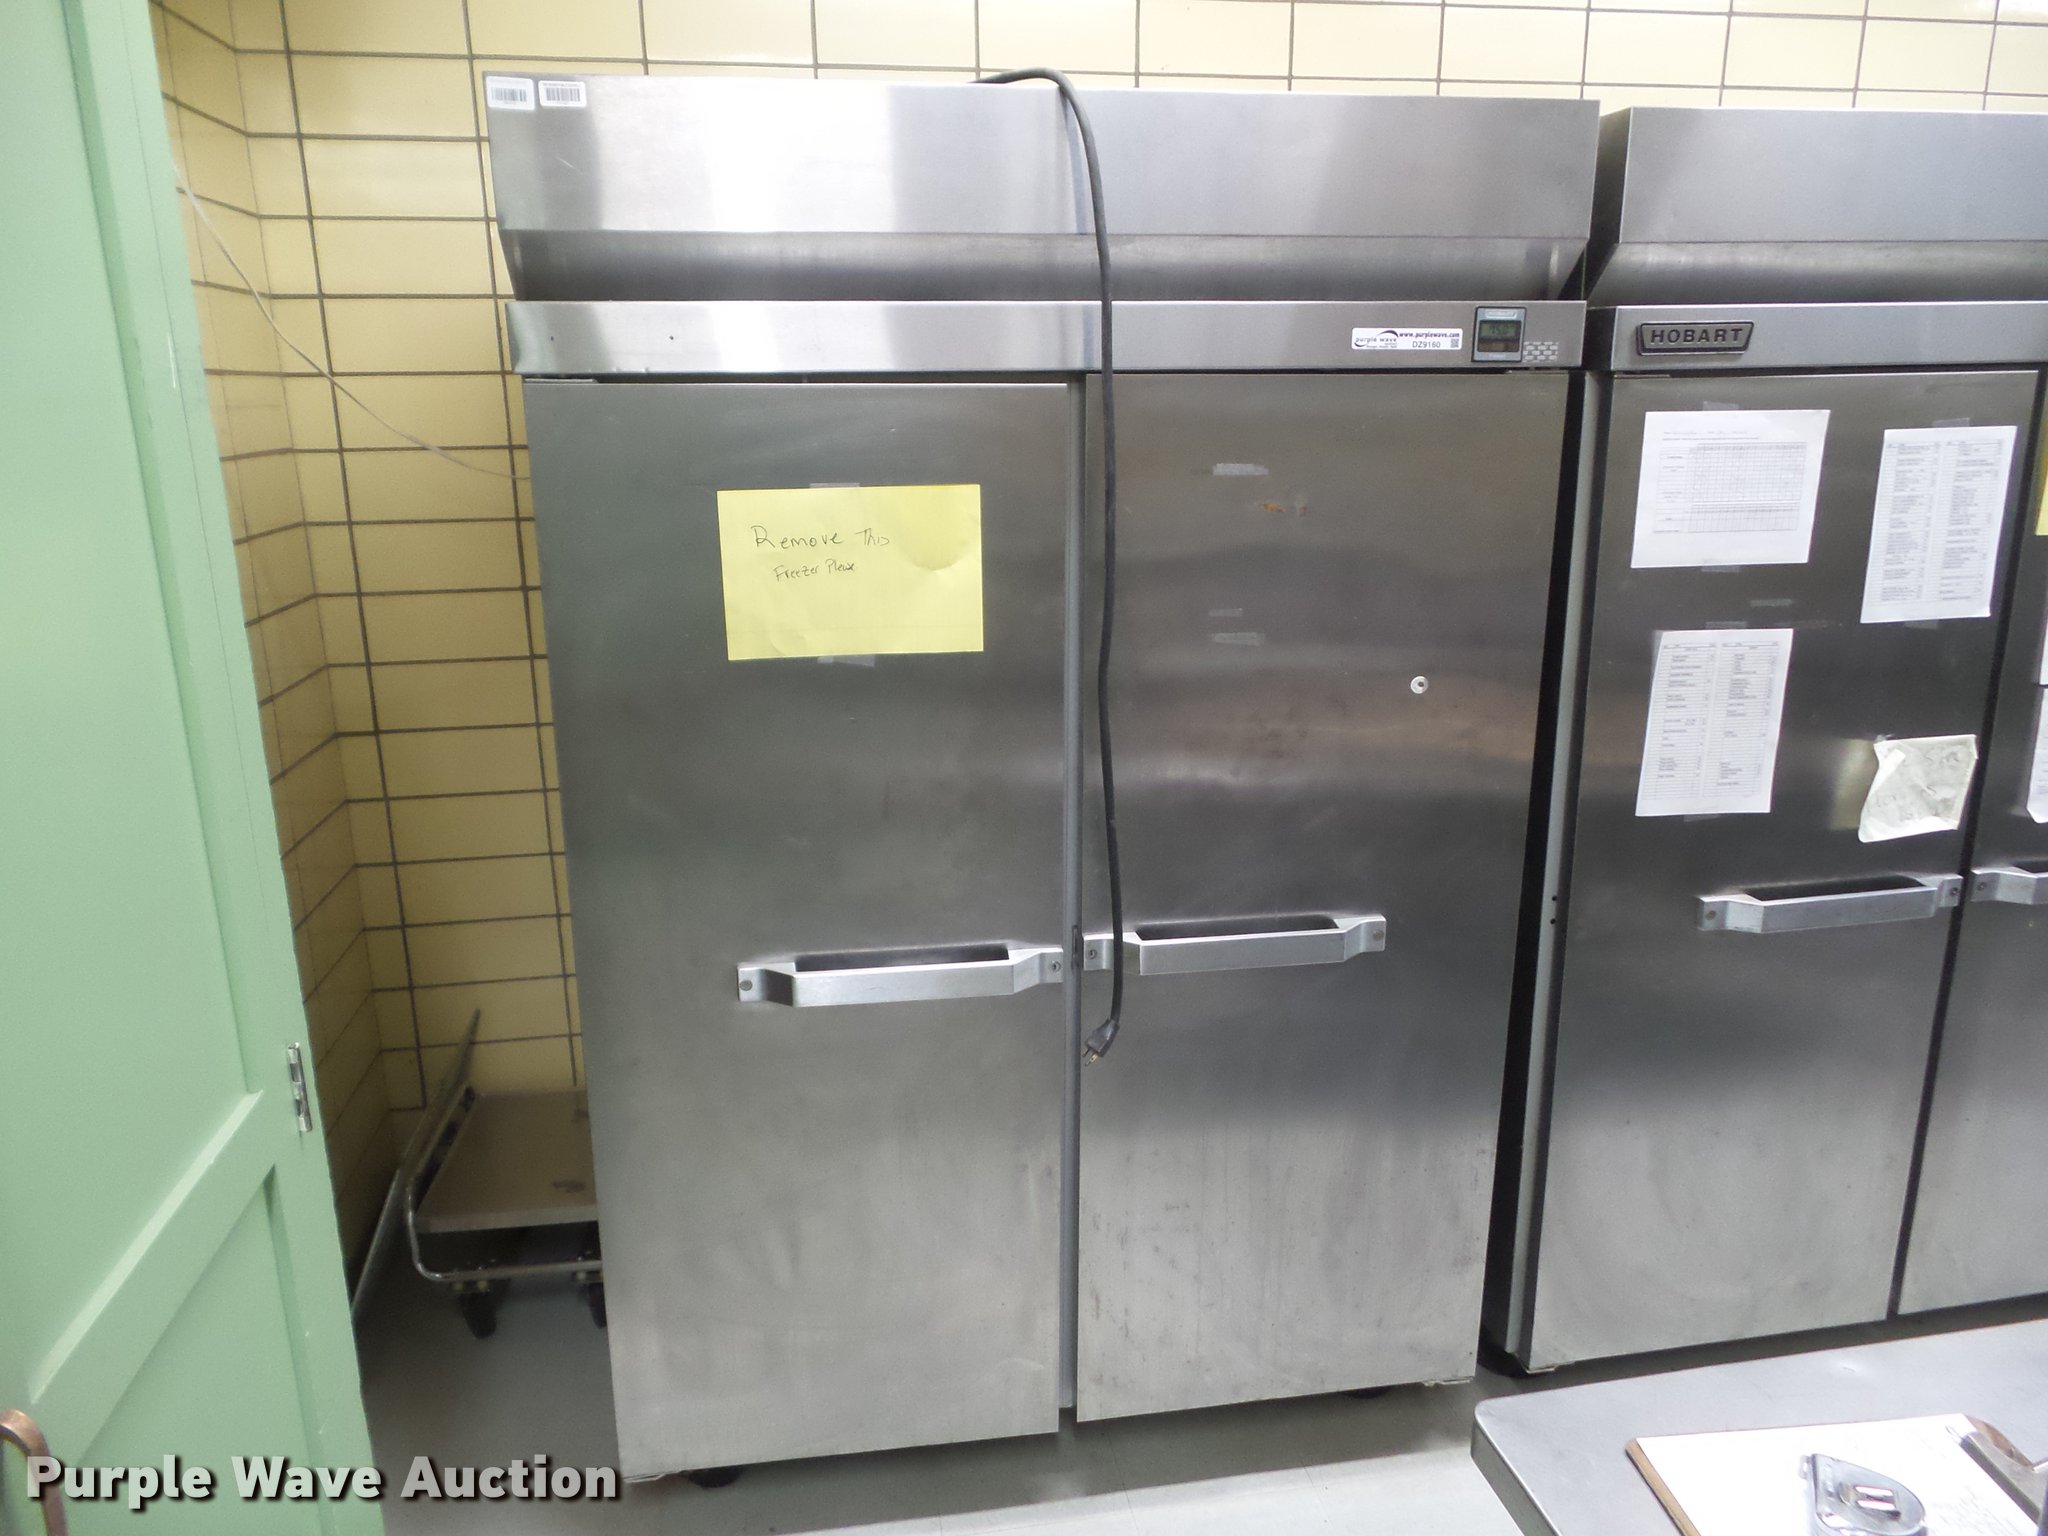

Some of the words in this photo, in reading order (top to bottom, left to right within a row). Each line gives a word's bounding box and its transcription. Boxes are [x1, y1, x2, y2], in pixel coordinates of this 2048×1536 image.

[1399, 331, 1460, 340] www.purplewave.com
[1650, 328, 1743, 343] HOBART
[1412, 340, 1441, 348] DZ9160
[750, 525, 844, 550] Remove
[855, 527, 890, 547] This
[773, 564, 820, 582] Freezer
